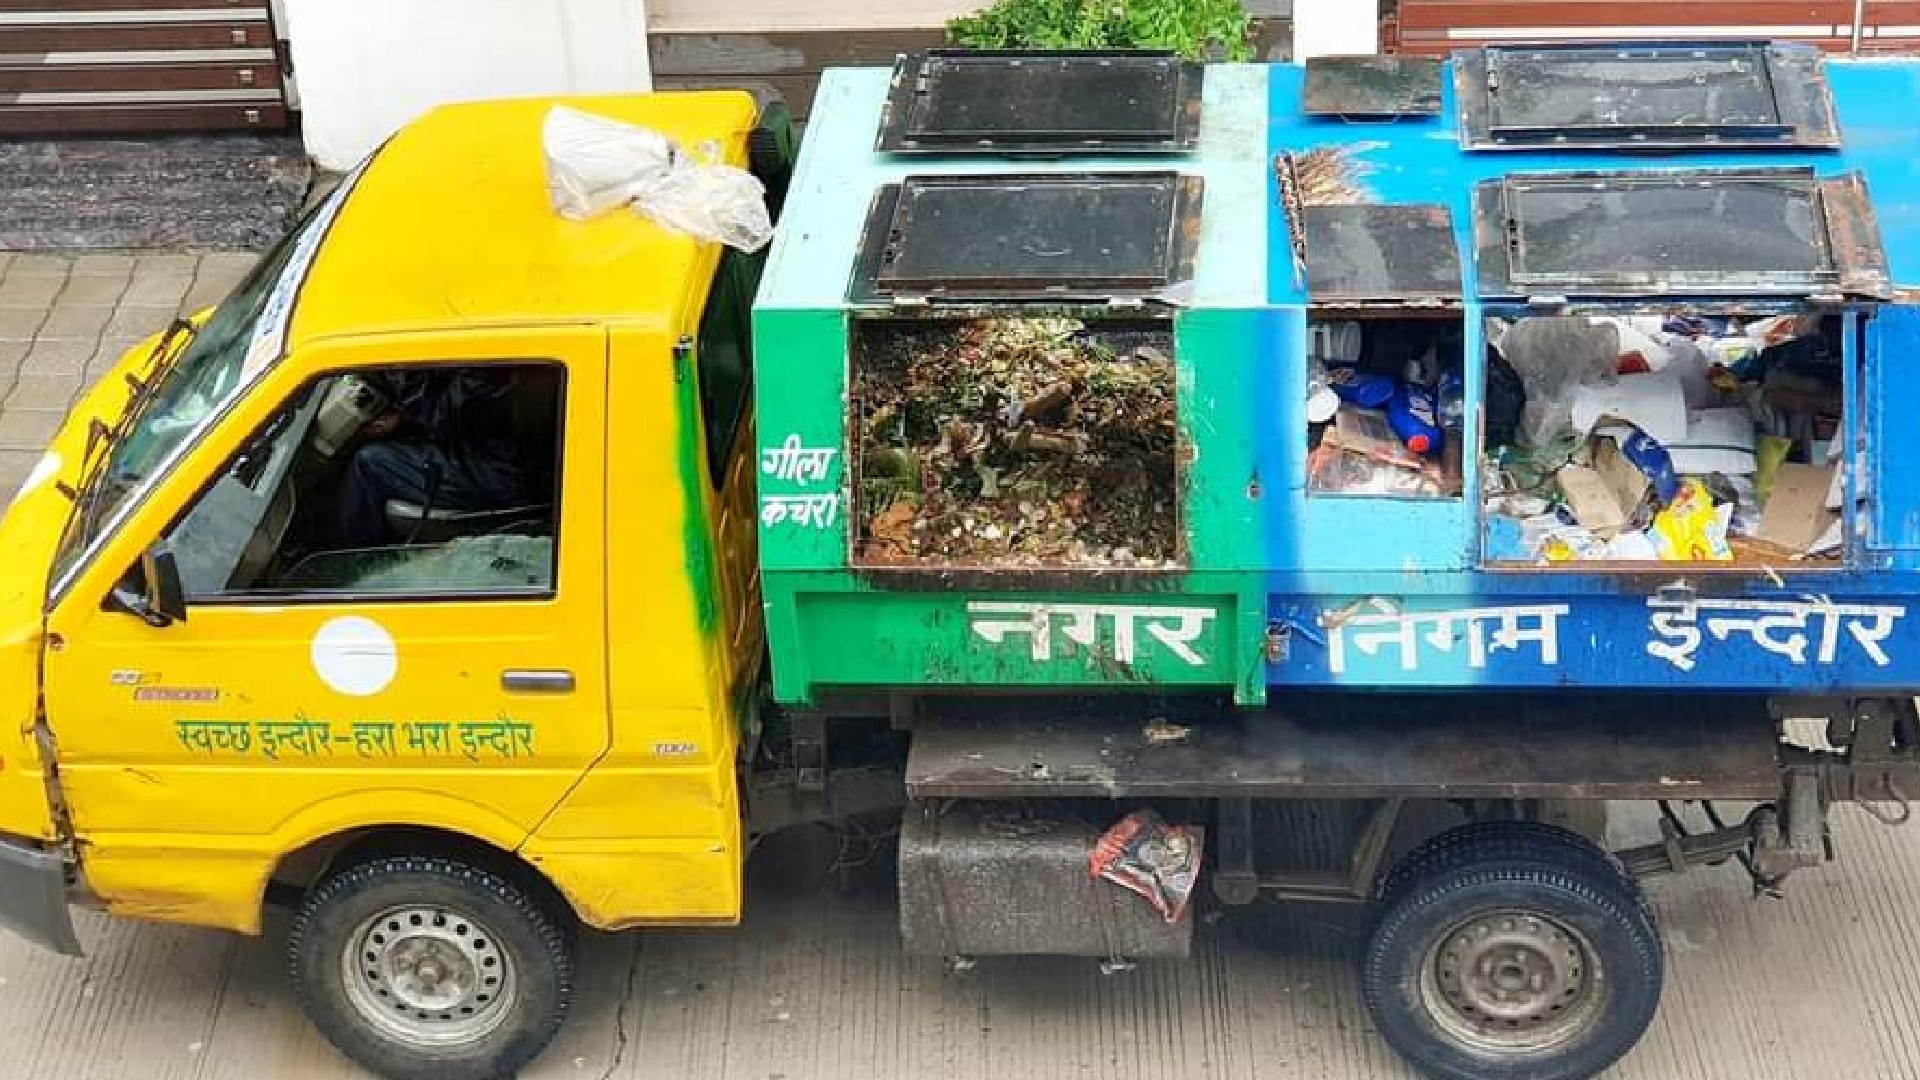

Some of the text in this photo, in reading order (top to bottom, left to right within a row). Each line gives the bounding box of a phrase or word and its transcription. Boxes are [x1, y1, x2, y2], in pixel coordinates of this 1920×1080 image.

[761, 434, 838, 486] गीला
[761, 493, 838, 529] कचरा
[967, 601, 1217, 665] नगर
[1317, 595, 1569, 673] निगम
[175, 721, 249, 755] स्वच्छ
[402, 721, 450, 757] भरा
